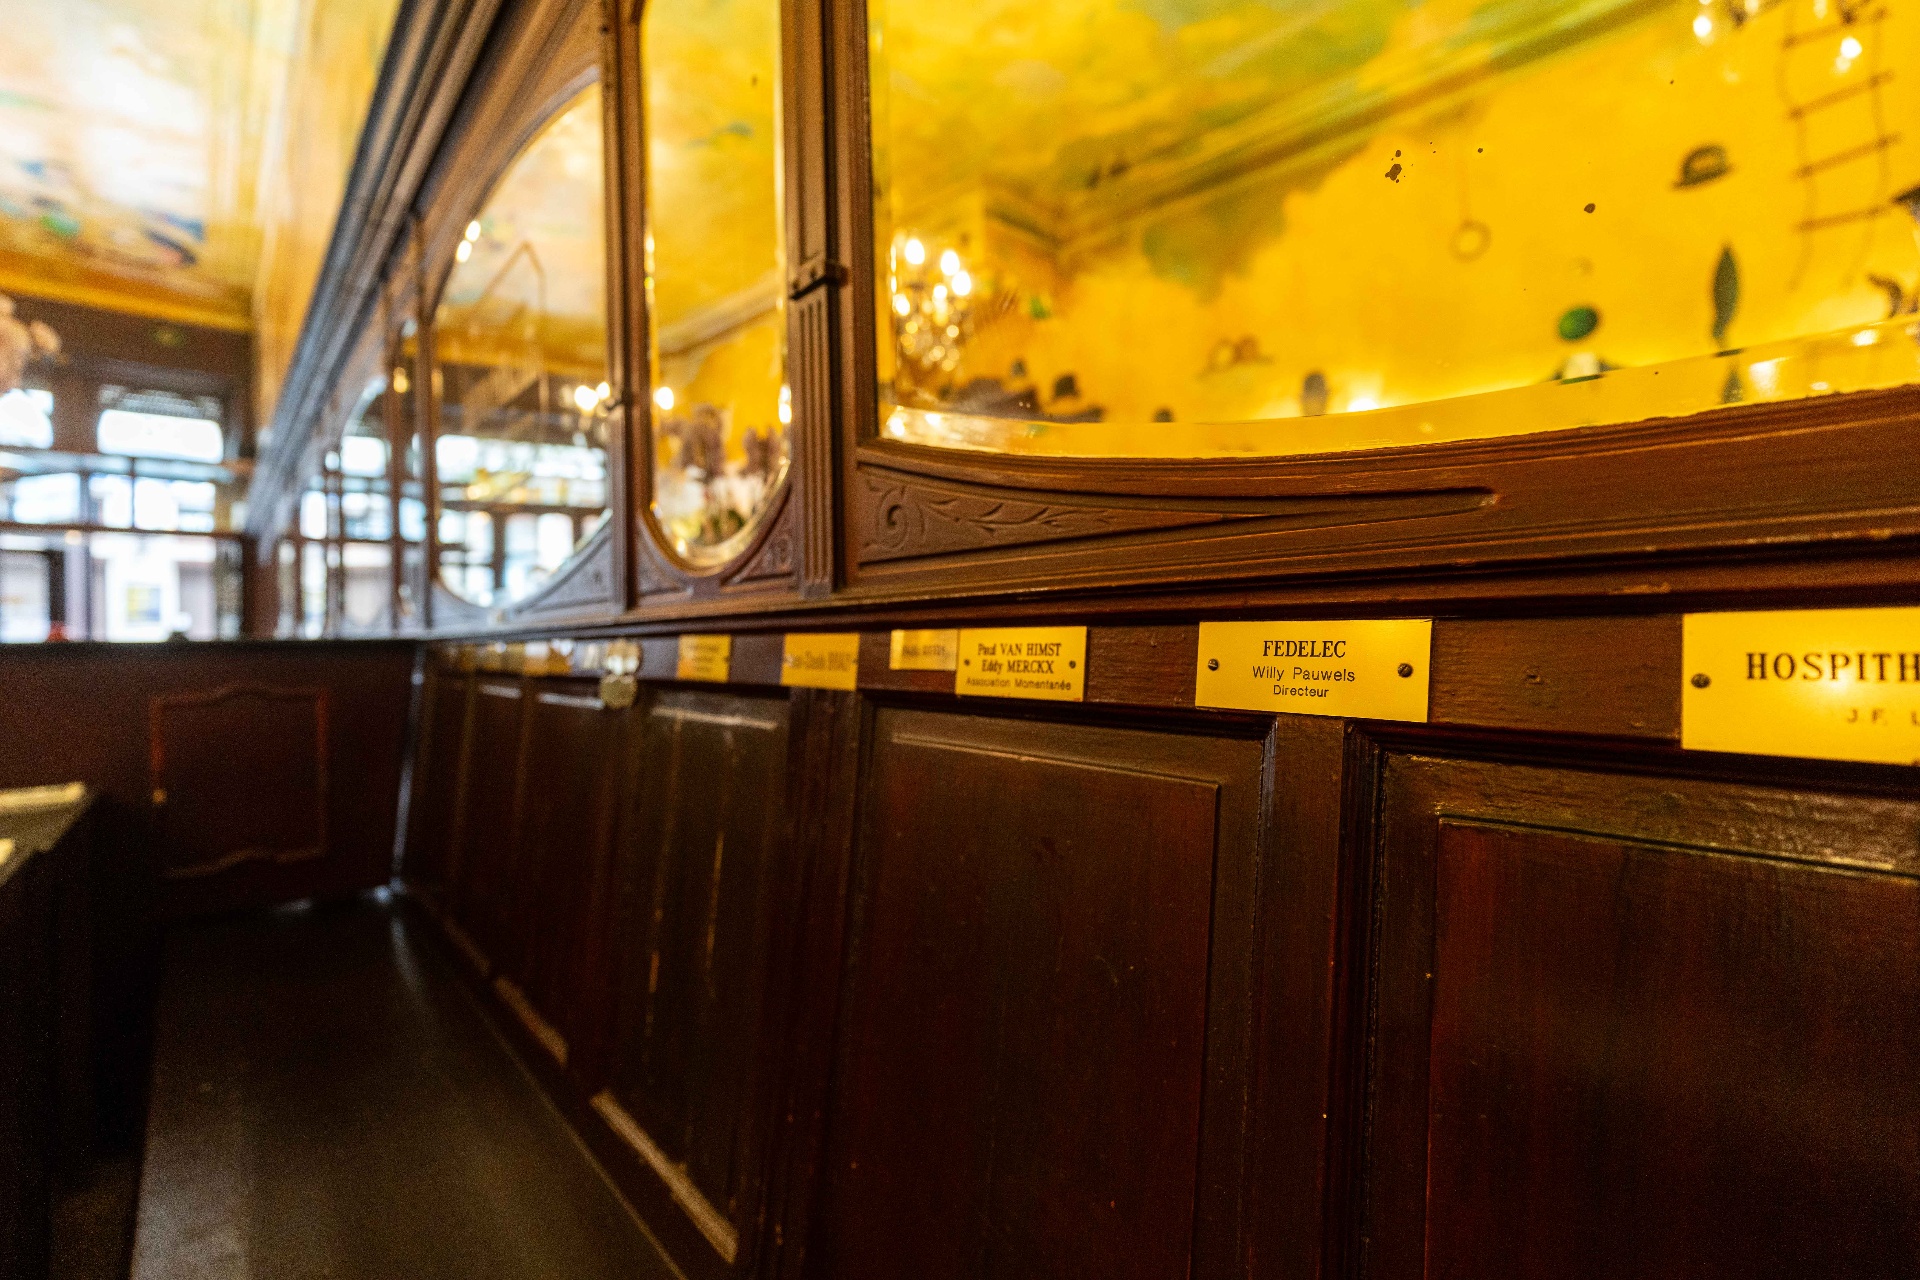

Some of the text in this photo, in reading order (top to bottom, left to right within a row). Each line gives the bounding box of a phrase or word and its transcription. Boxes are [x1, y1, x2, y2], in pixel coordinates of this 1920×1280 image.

[1000, 643, 1022, 656] VAN
[1026, 643, 1062, 656] HIMST
[1263, 640, 1346, 658] FEDELEC
[981, 660, 1054, 674] Eddy MERCKX
[1253, 665, 1356, 683] Willy Pauwels
[1746, 652, 1920, 681] HOSPITH
[1273, 685, 1329, 697] Directeur
